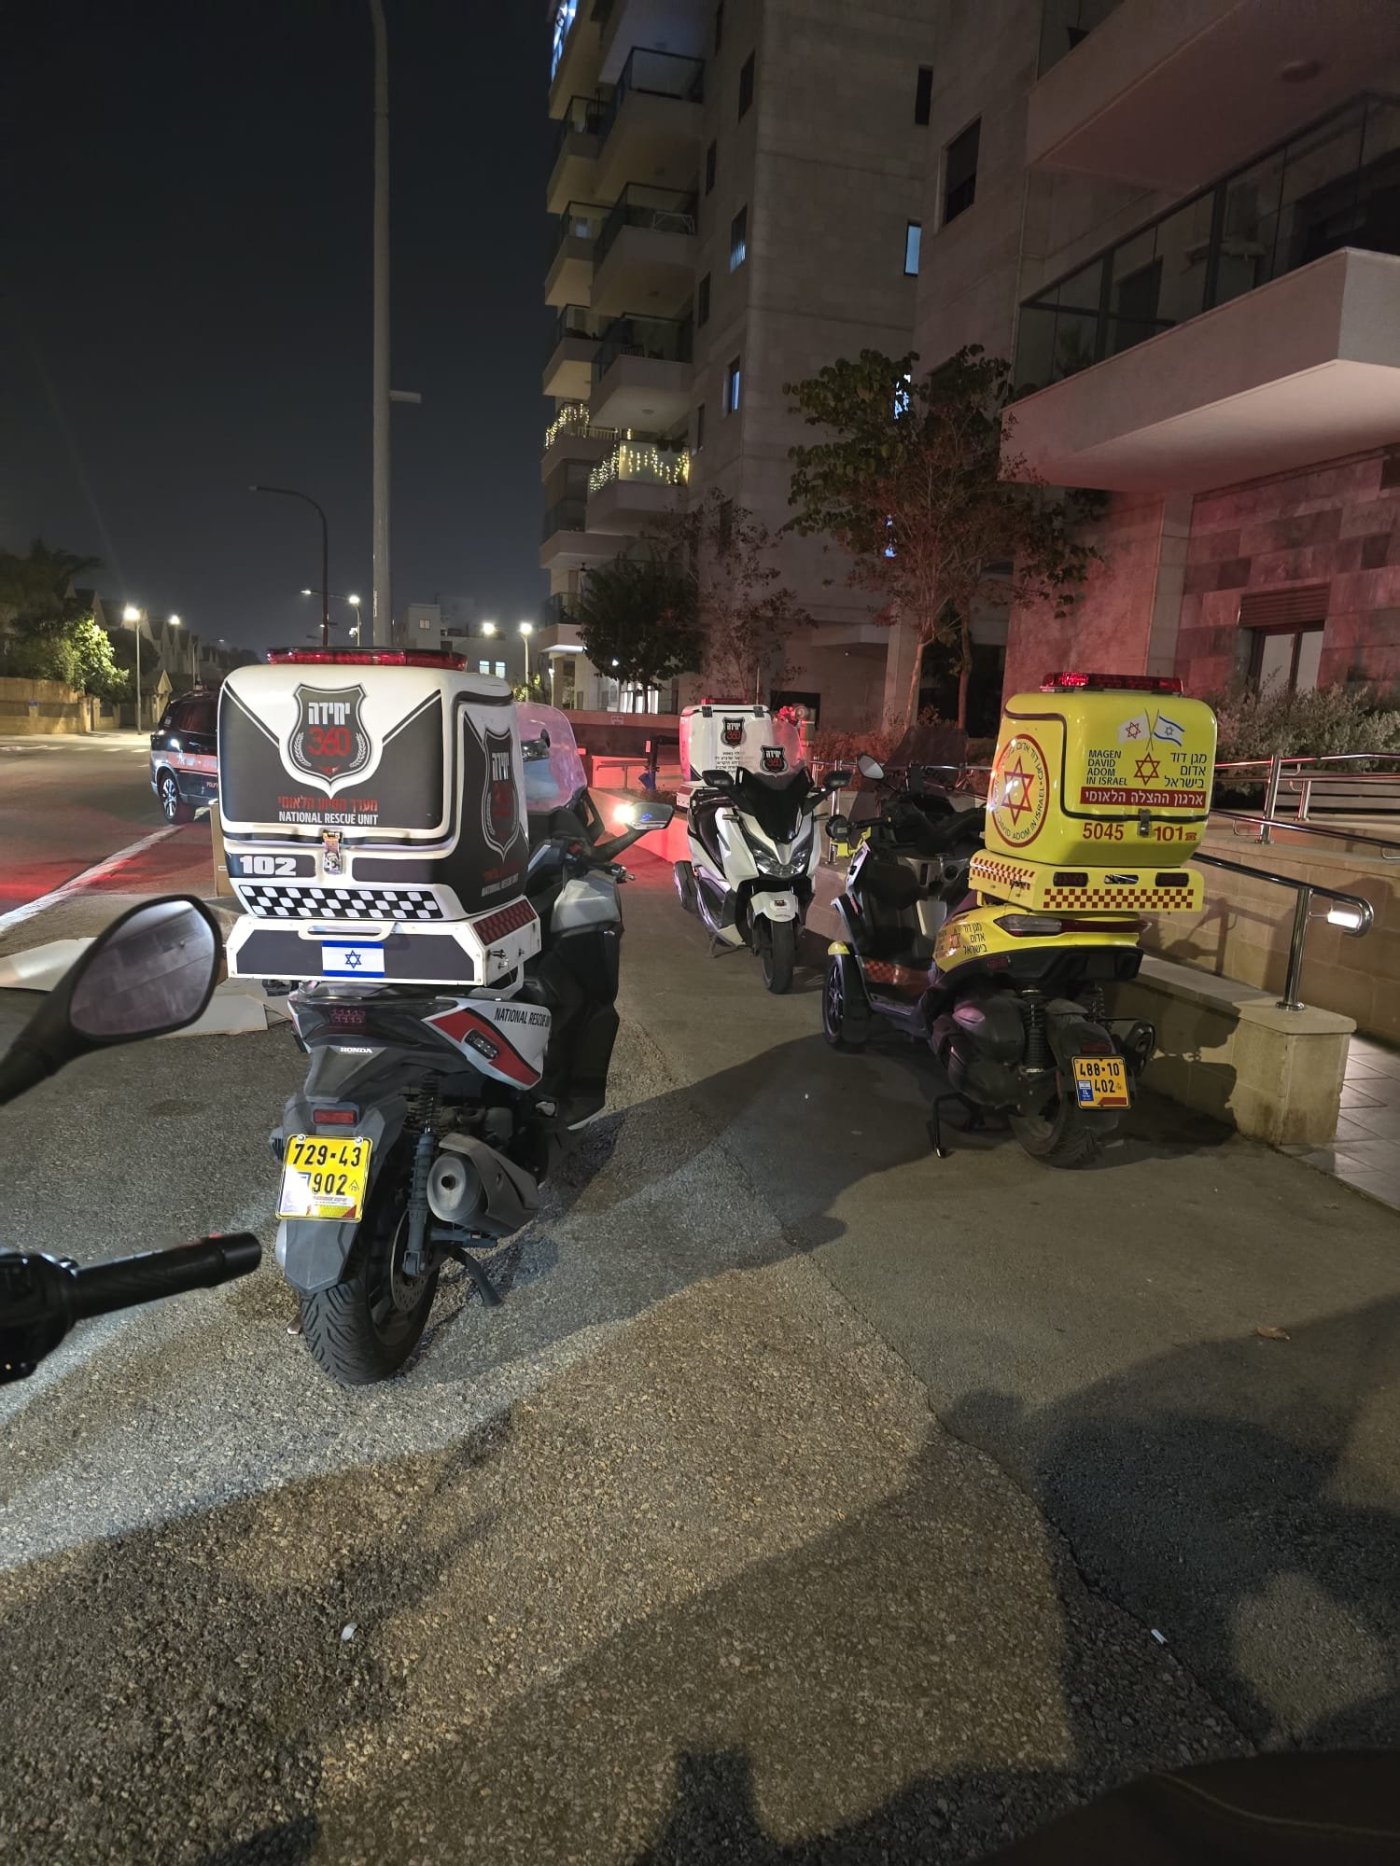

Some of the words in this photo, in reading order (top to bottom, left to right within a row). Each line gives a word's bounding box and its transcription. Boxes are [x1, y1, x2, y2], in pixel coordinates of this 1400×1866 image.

[308, 702, 350, 725] יחידה
[307, 725, 351, 756] 360
[1088, 750, 1121, 758] MAGEN
[1170, 752, 1187, 762] דוד
[1191, 754, 1207, 765] מגן
[1087, 759, 1116, 767] DAVID
[1087, 768, 1115, 776] ADOM
[1180, 765, 1206, 776] אדום
[1086, 777, 1095, 785] IN
[1098, 777, 1127, 786] ISRAEL
[1164, 776, 1204, 788] בישראל
[1085, 789, 1126, 803] הלאומי
[1131, 790, 1170, 804] ההצלה
[1174, 793, 1204, 807] ארגון
[279, 811, 322, 824] NATIONAL
[324, 813, 356, 825] RESCUE
[357, 814, 379, 825] UNIT
[1083, 822, 1124, 841] 5045
[1154, 826, 1183, 841] 101
[240, 855, 297, 876] 102
[494, 1008, 528, 1024] NATIONAL
[1080, 1063, 1120, 1076] 488-10
[1094, 1079, 1115, 1093] 402
[293, 1143, 362, 1167] 729-43
[312, 1172, 347, 1195] 902
